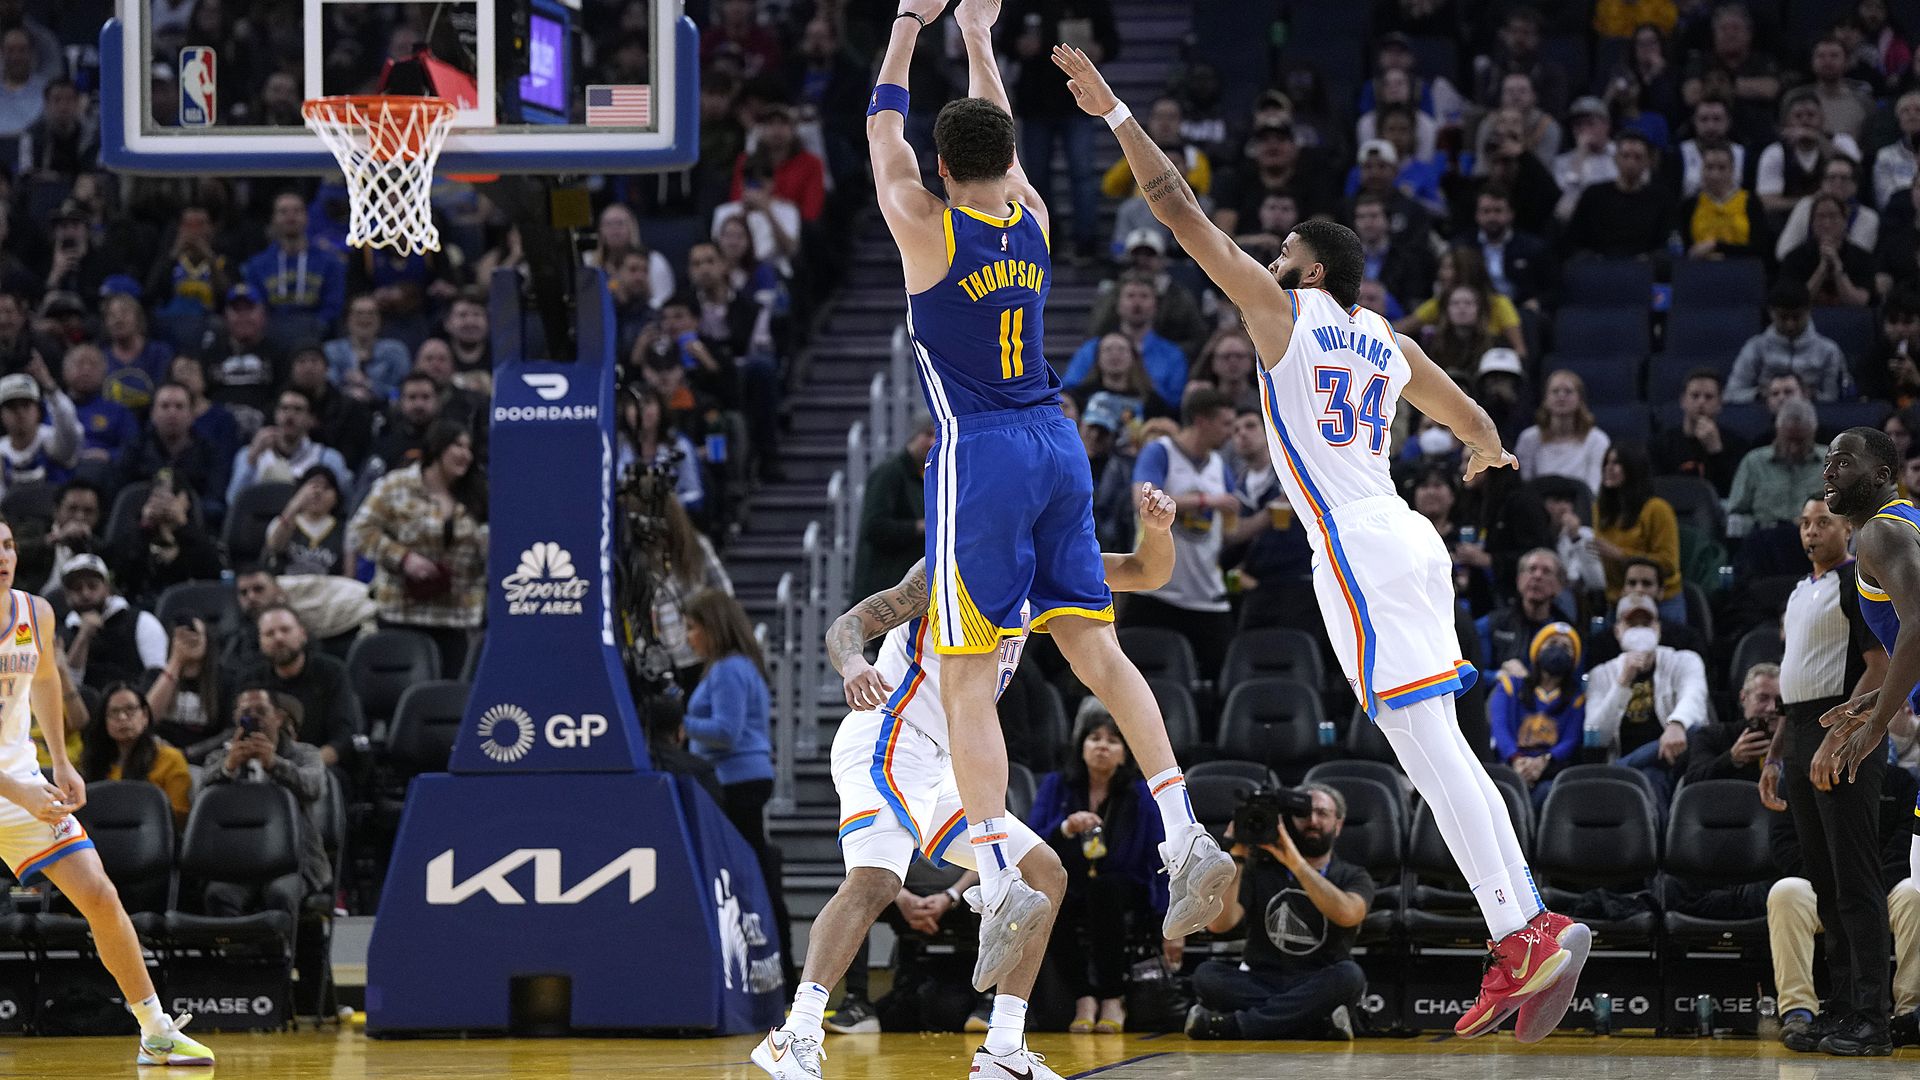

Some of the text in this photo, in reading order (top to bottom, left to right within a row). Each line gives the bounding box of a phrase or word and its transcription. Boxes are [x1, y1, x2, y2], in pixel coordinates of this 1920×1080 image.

[957, 259, 1045, 302] THOMPSON
[999, 307, 1024, 379] 11
[494, 404, 598, 421] DOORDASH
[1314, 366, 1390, 455] 34
[501, 572, 590, 604] Sports
[508, 600, 583, 615] BAY AREA
[426, 847, 657, 905] KIA
[172, 997, 250, 1014] CHASE
[1414, 999, 1475, 1015] CHAS
[1569, 997, 1626, 1014] HAE
